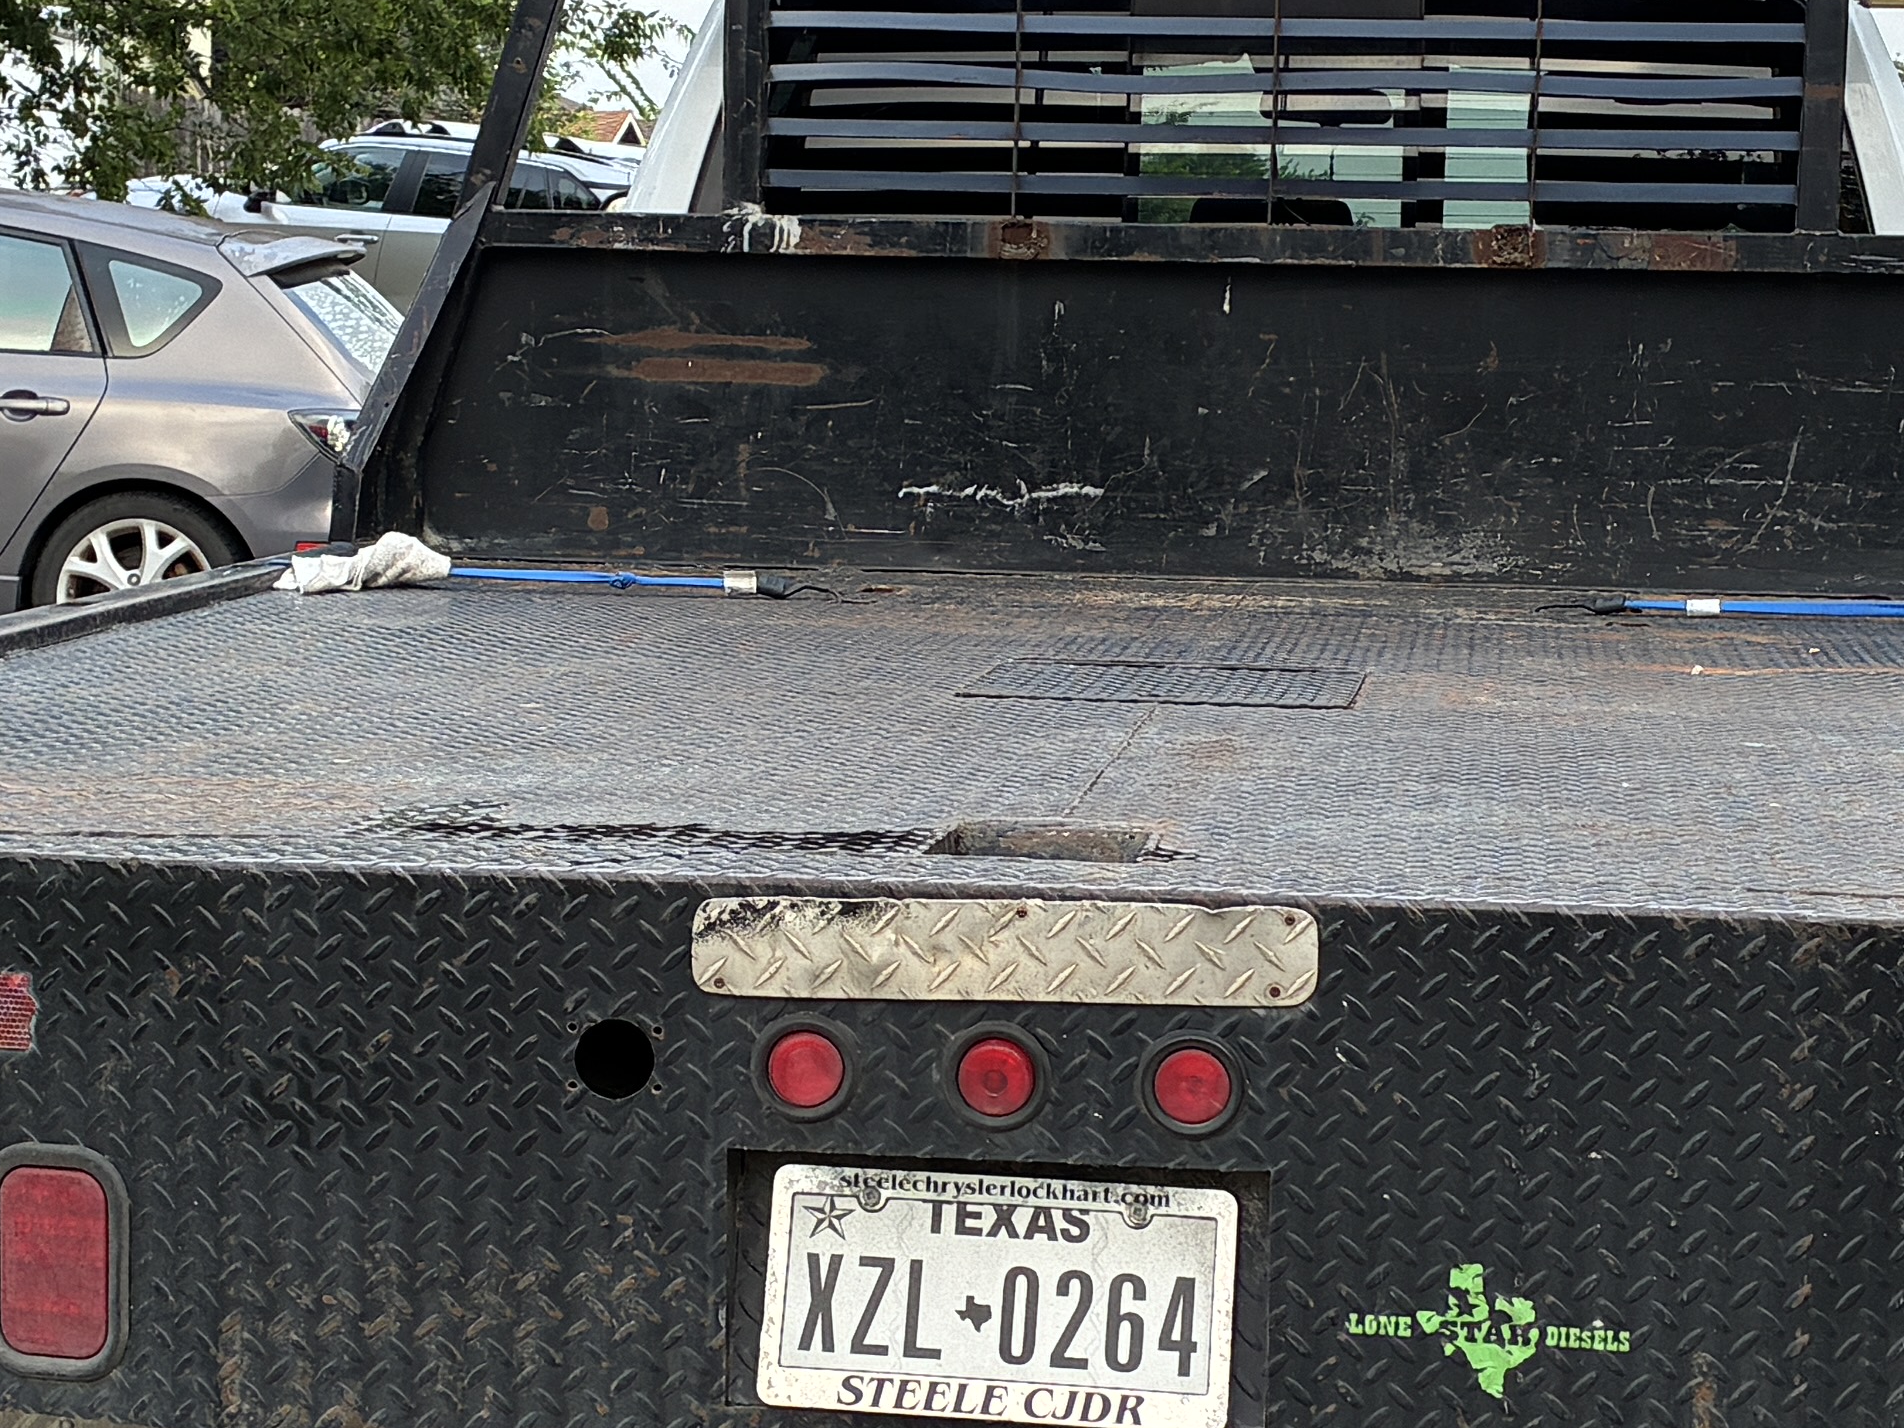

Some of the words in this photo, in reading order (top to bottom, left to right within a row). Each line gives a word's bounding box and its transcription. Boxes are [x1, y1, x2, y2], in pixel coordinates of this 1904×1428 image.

[838, 1172, 1171, 1209] steelechryslerlockhart.com
[922, 1200, 1091, 1244] TEXAS
[797, 1252, 942, 1360] XZL
[999, 1266, 1198, 1378] 0264
[1347, 1313, 1412, 1338] LONE
[1545, 1325, 1630, 1353] DIESELS
[836, 1375, 1008, 1417] STEELE
[1023, 1385, 1144, 1427] CJDR
